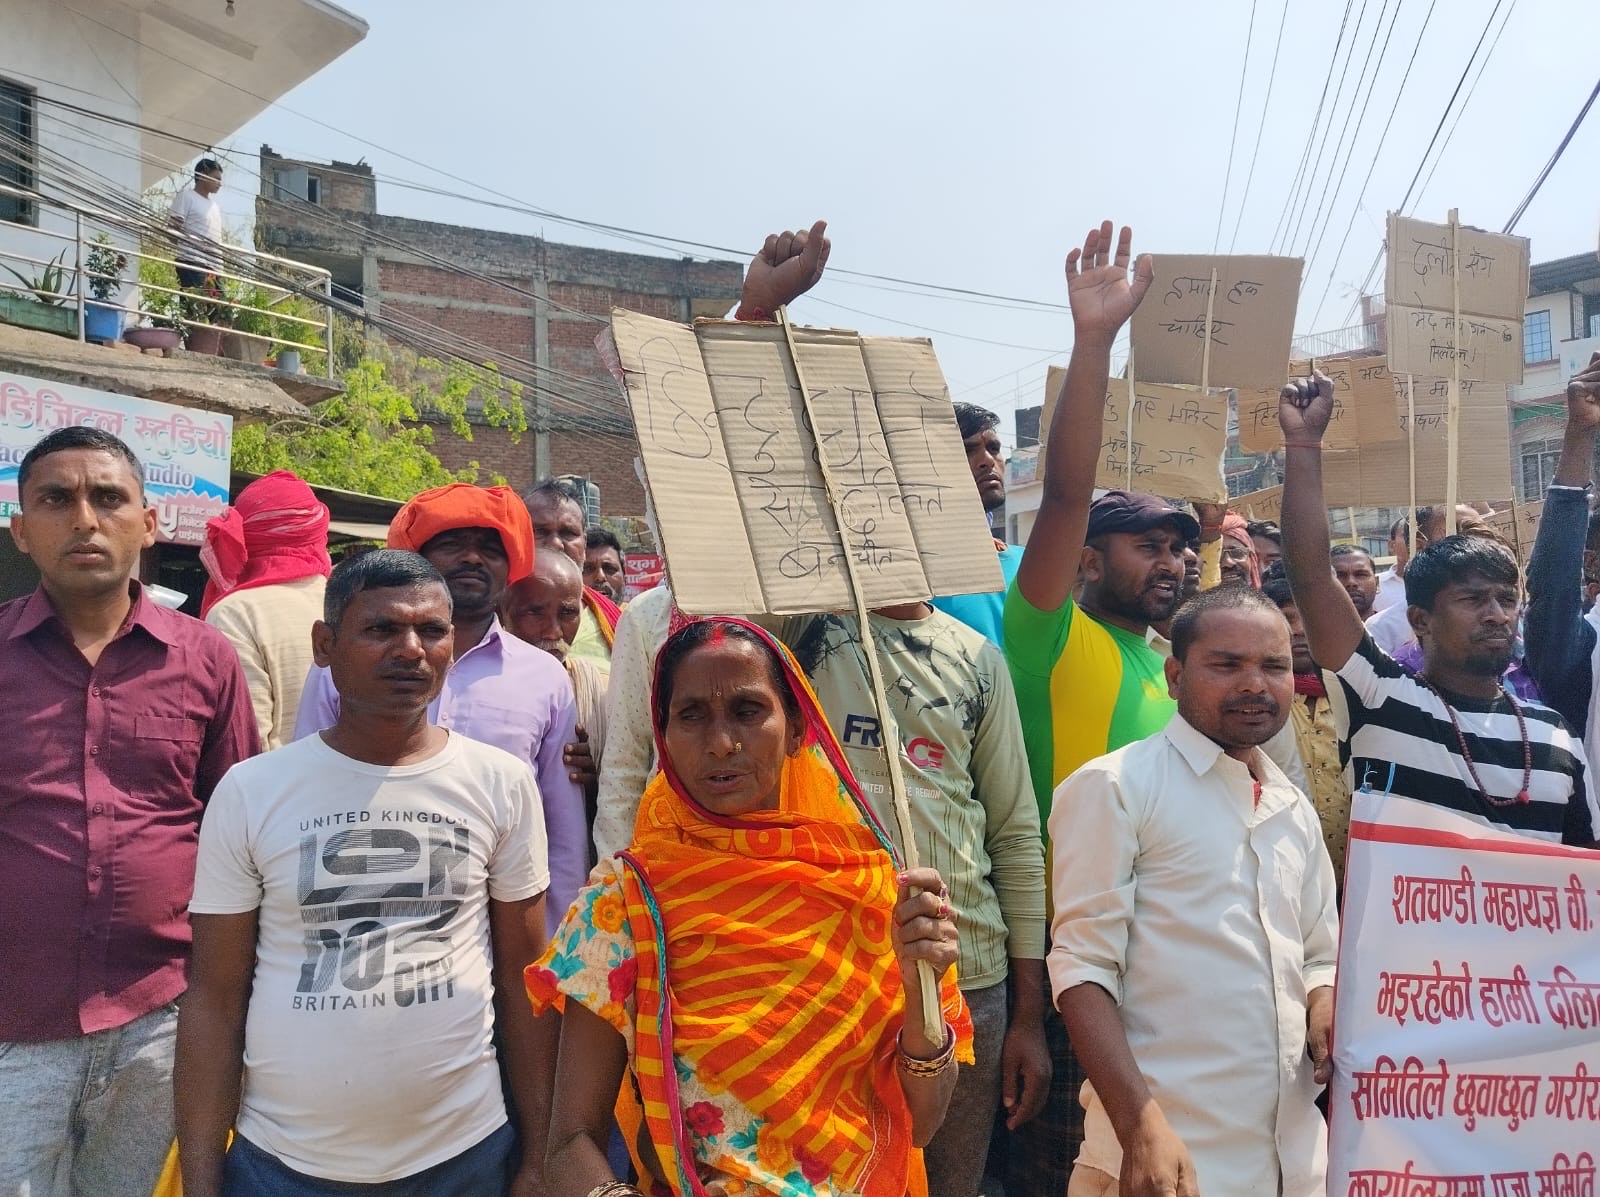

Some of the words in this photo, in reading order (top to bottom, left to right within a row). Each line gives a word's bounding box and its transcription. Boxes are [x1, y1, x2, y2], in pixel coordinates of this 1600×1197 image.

[134, 414, 230, 460] स्टुडियो
[626, 559, 656, 572] शुभ
[915, 787, 941, 800] REGION
[300, 811, 371, 831] UNITED
[1392, 864, 1477, 925] शतचण्डी
[1482, 881, 1561, 934] महायज्ञ
[292, 992, 387, 1012] BRITAIN
[1377, 960, 1475, 1027] भइरहेको
[1479, 964, 1541, 1028] हामी
[1350, 1054, 1451, 1121] समितिले
[1453, 1073, 1542, 1133] छुवाछुत
[1545, 1062, 1600, 1121] गरीर
